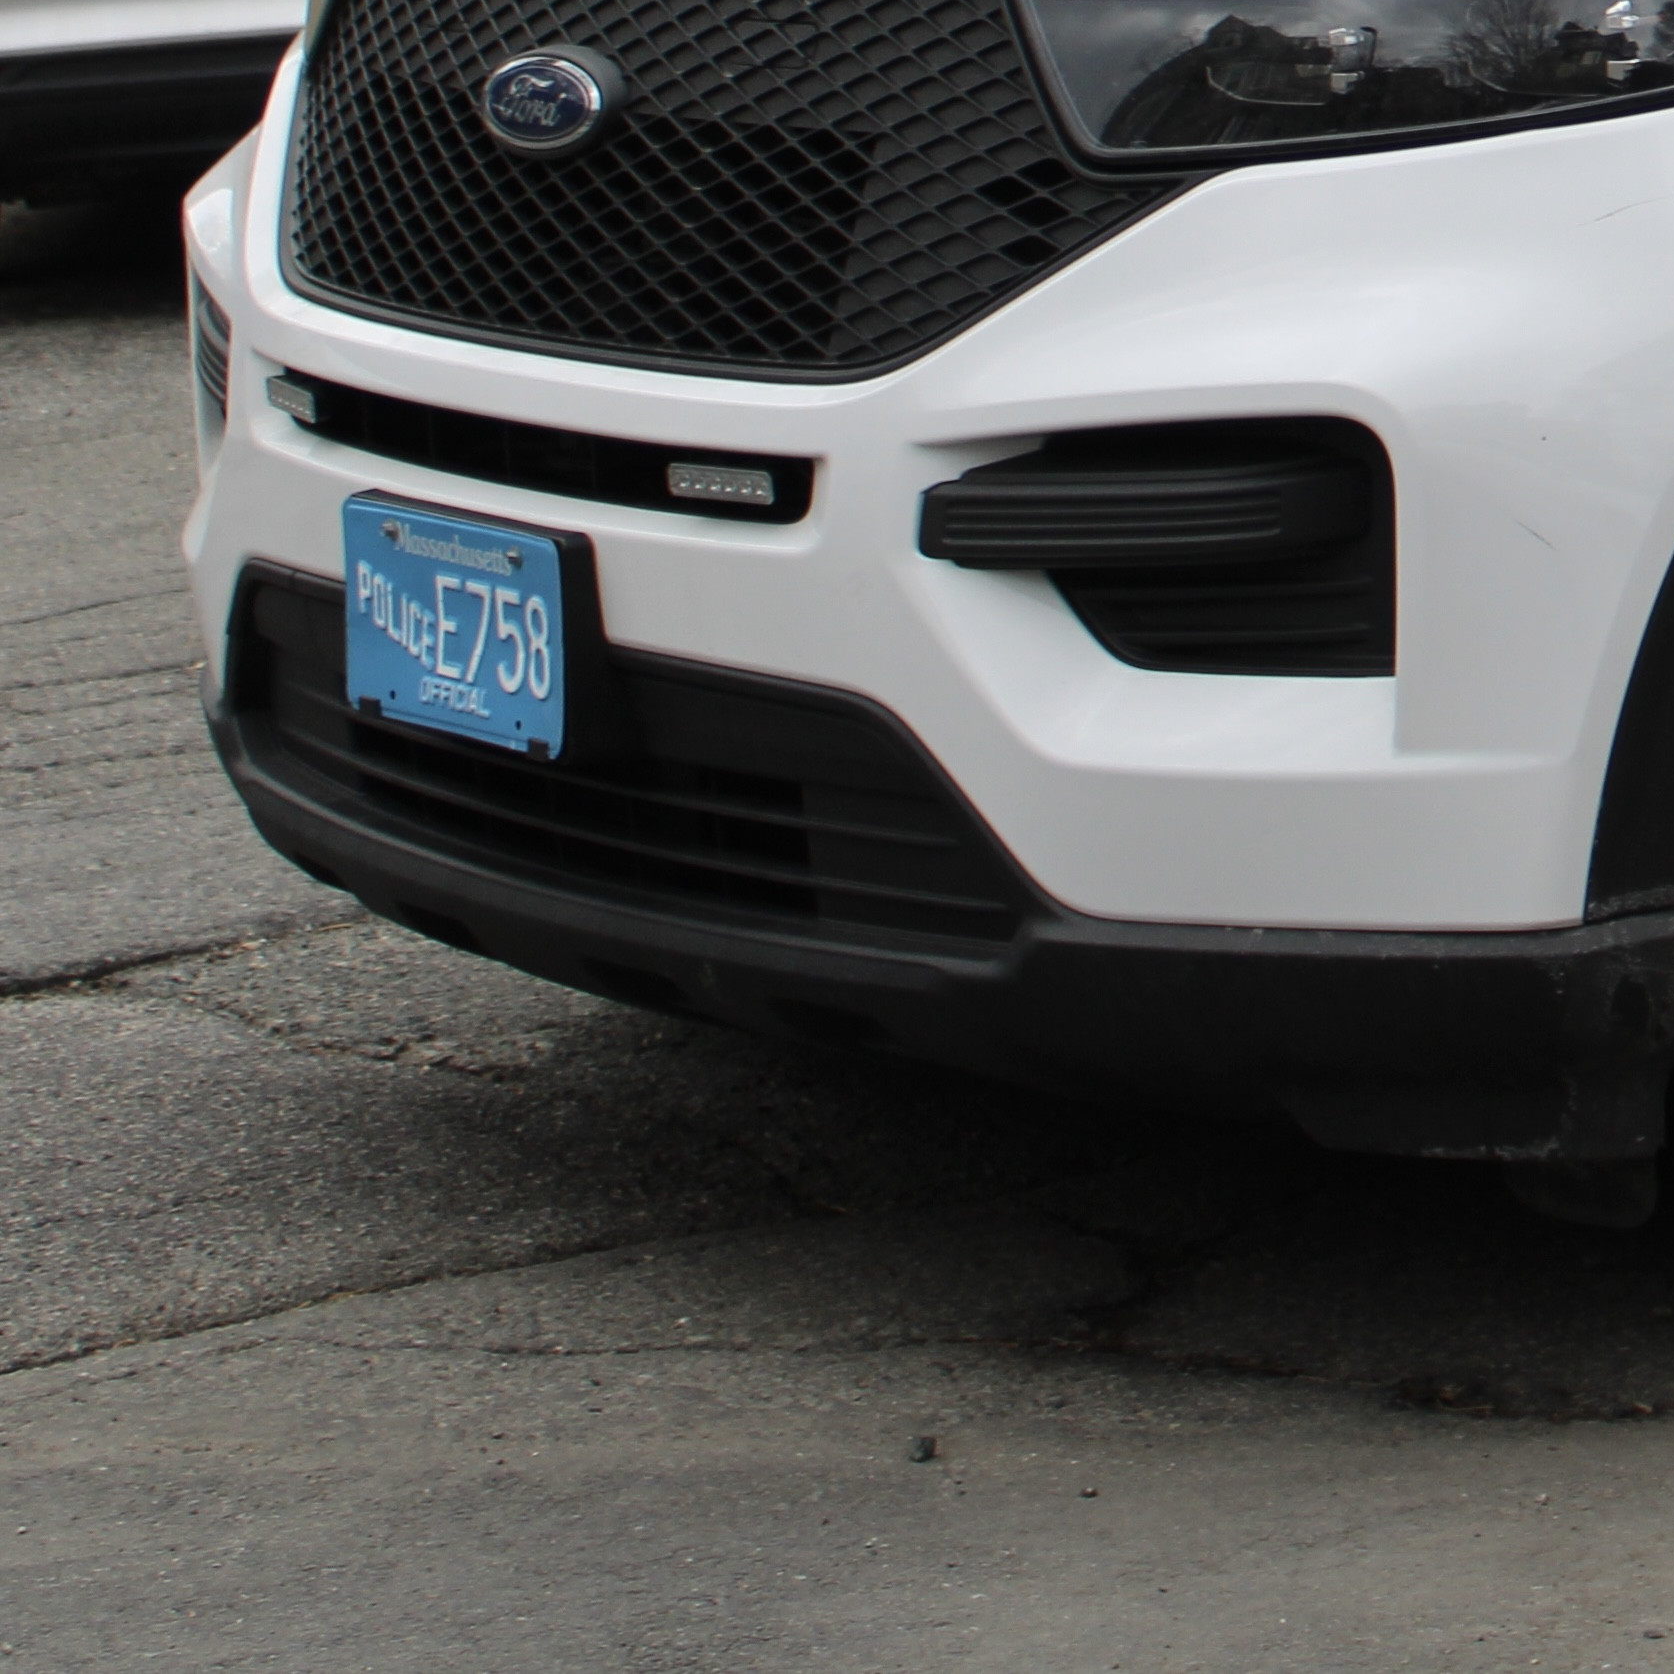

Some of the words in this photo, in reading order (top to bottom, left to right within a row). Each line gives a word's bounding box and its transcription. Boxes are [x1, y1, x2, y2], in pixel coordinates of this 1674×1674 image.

[492, 74, 567, 127] Ford
[394, 523, 513, 576] Massachusetts
[357, 560, 437, 672] POLICE
[435, 574, 550, 702] E758
[420, 676, 492, 719] OFFICIAL
